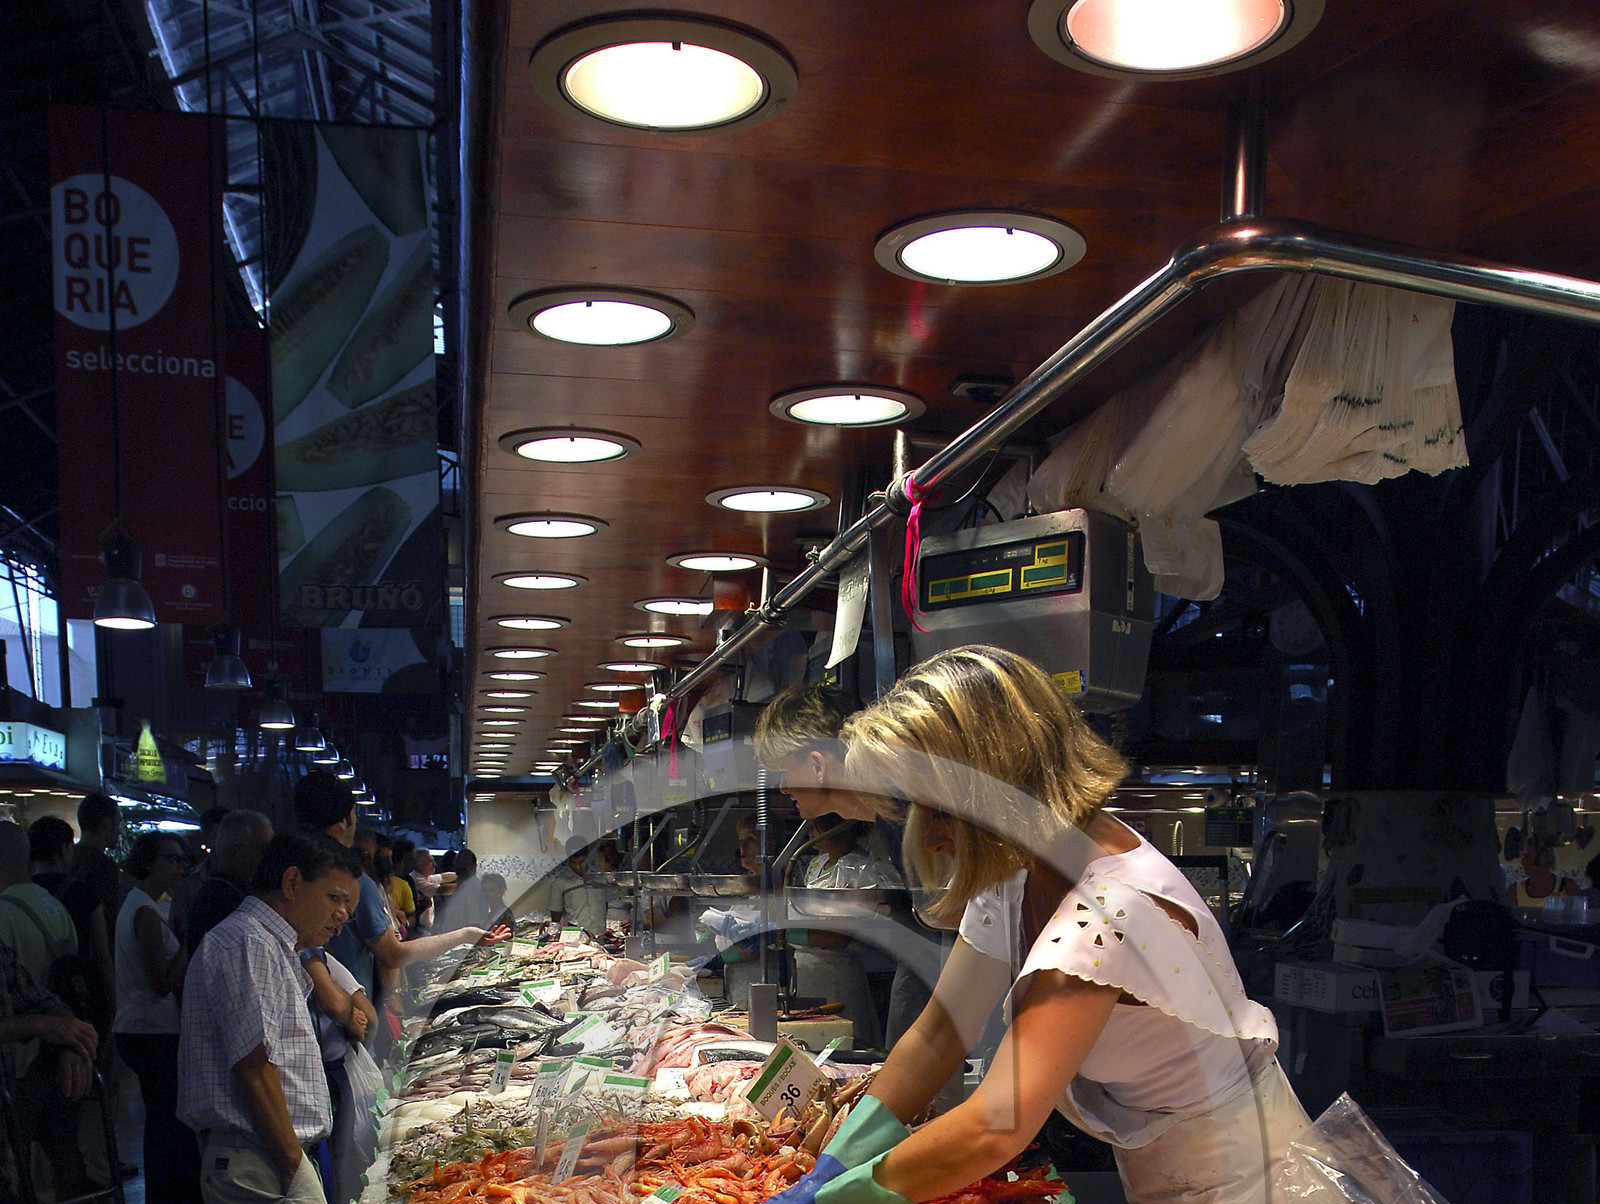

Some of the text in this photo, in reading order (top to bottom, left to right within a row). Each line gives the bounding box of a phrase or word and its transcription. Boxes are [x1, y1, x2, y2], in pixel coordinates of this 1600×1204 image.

[64, 188, 120, 227] BO
[64, 233, 152, 273] QUE
[66, 276, 139, 316] RIA
[65, 346, 216, 378] selecciona
[1352, 980, 1378, 999] cel
[780, 1083, 801, 1107] 36
